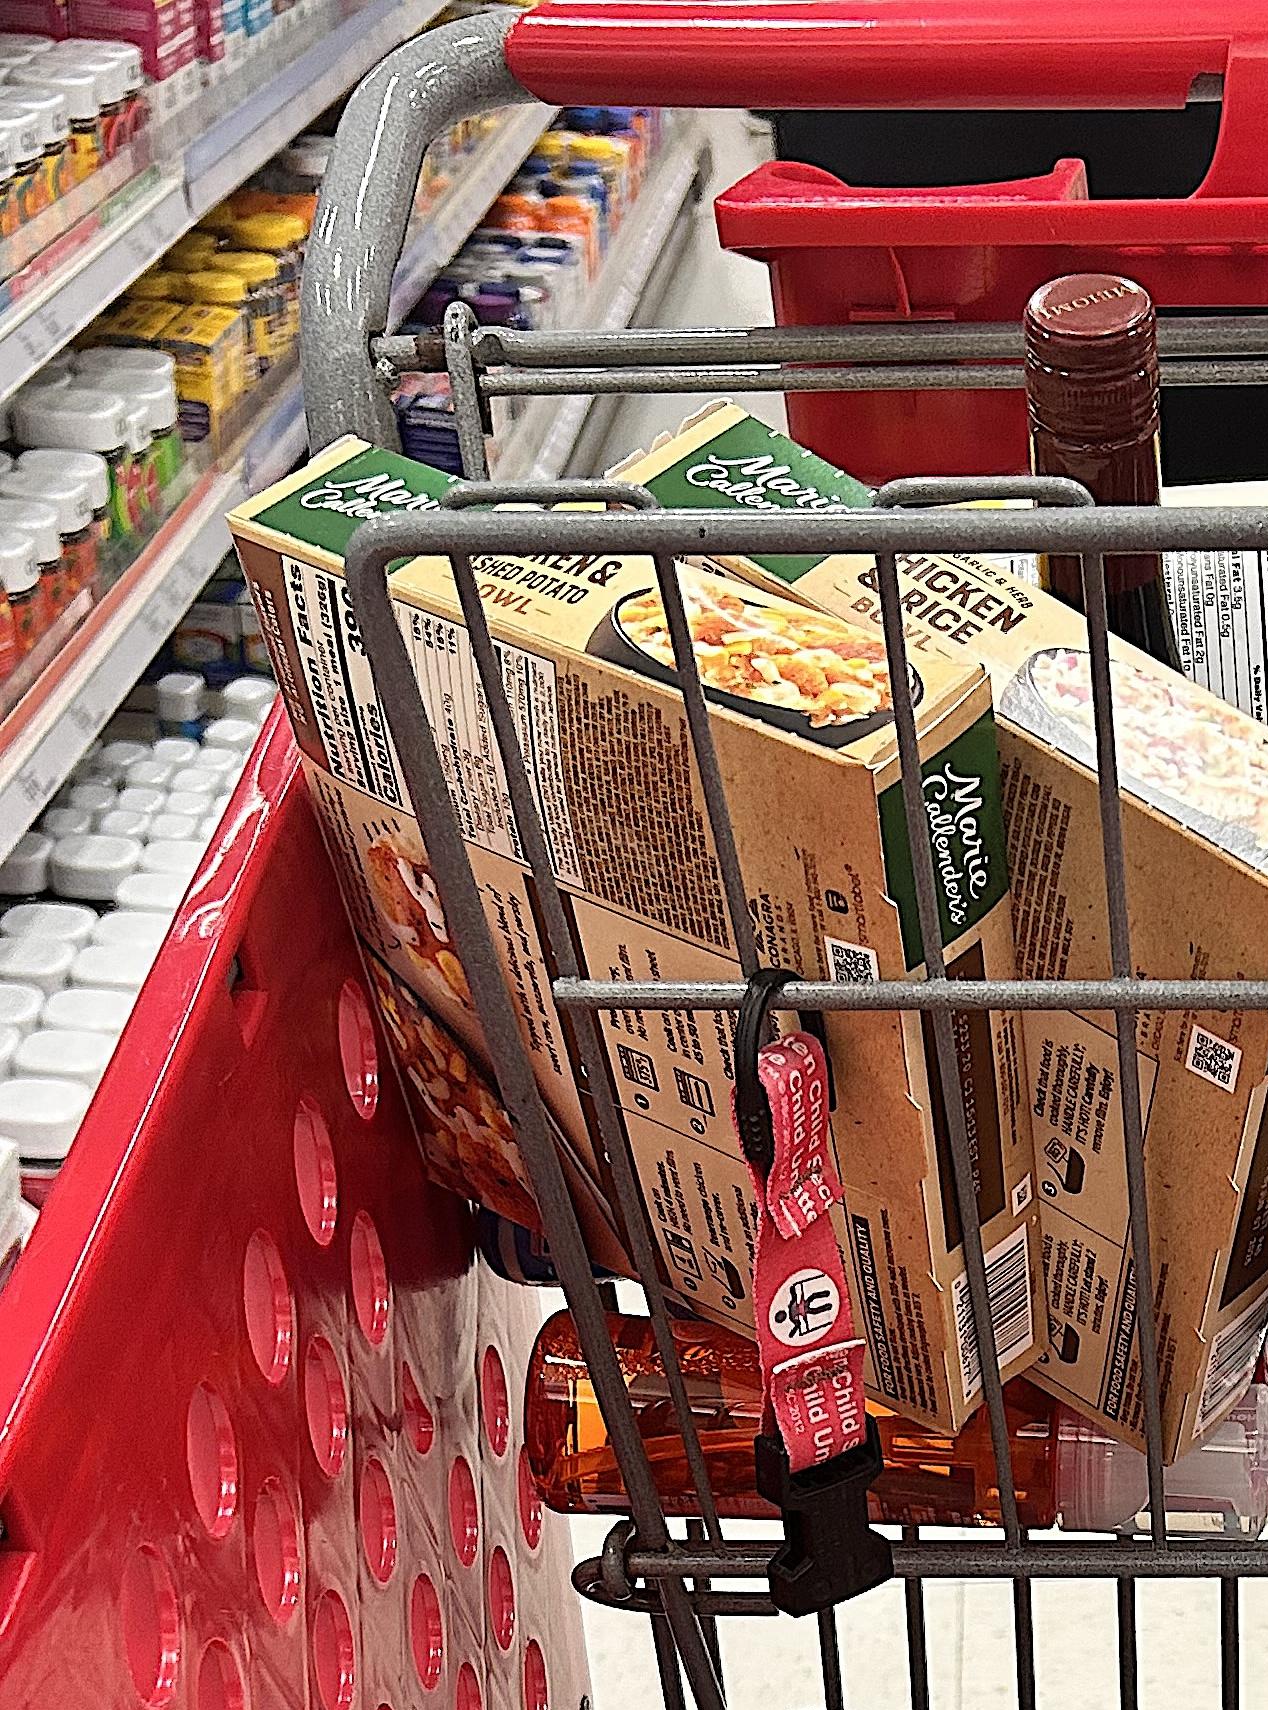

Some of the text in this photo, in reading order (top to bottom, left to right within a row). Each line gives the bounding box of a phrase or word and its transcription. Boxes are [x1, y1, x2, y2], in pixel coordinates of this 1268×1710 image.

[473, 556, 525, 580] SHED
[516, 571, 589, 604] POTATO
[1203, 573, 1214, 590] Fat
[1230, 563, 1242, 583] Fat
[479, 584, 532, 615] OWL
[897, 556, 1027, 634] HICKEN
[1005, 586, 1033, 608] HERB
[1219, 594, 1231, 611] Fat
[288, 561, 346, 779] Nutrition Facts
[315, 638, 336, 702] container
[321, 631, 340, 675] meal
[332, 678, 341, 688] 1
[335, 693, 351, 728] size
[344, 729, 366, 789] Serving
[362, 699, 397, 804] Calories
[506, 813, 522, 860] Protein
[944, 763, 988, 904] Marie
[758, 892, 781, 968] CONAGRA
[854, 1223, 895, 1394] FOR FOOD SAFETY AND QUALITY
[1120, 1311, 1133, 1332] AND
[1113, 1331, 1129, 1369] SAFETY
[1109, 1369, 1122, 1395] FOOD
[1106, 1395, 1118, 1415] FOR
